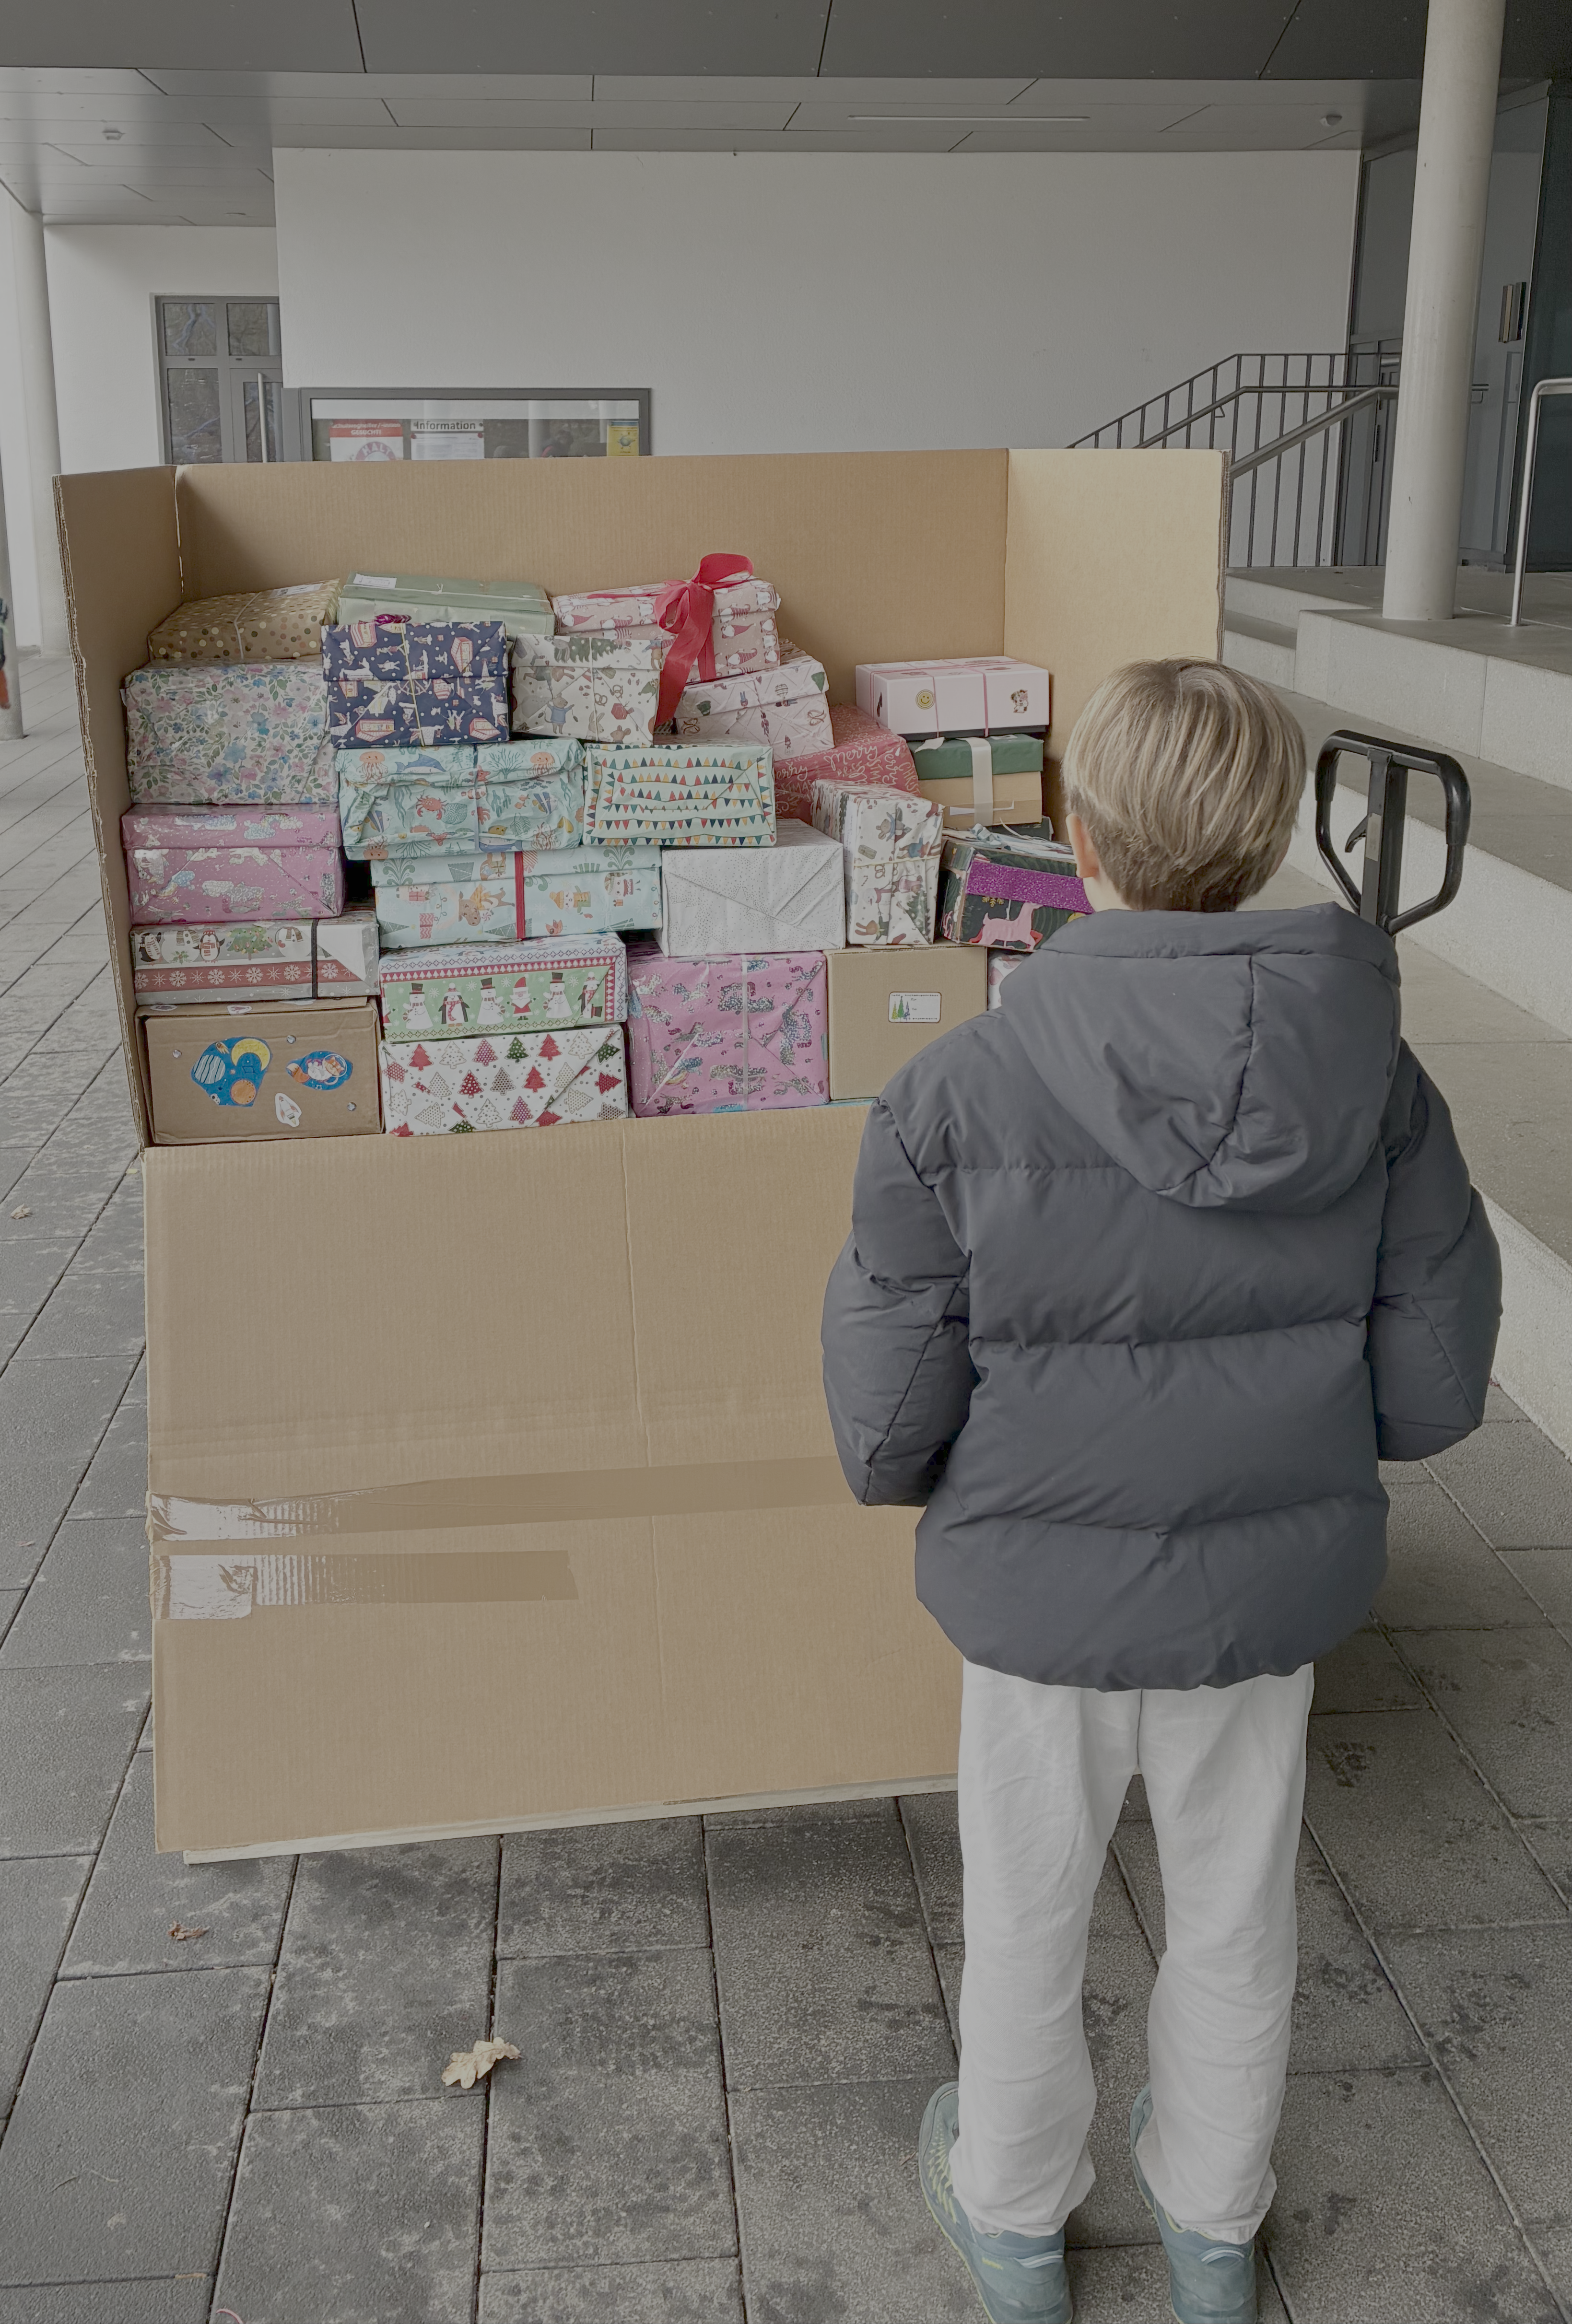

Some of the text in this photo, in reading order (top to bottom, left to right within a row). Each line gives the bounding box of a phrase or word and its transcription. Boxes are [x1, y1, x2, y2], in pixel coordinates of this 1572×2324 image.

[416, 421, 476, 430] Information
[362, 443, 392, 456] HALT
[776, 765, 808, 781] erry
[882, 749, 898, 785] erry
[898, 762, 921, 794] CHRIST
